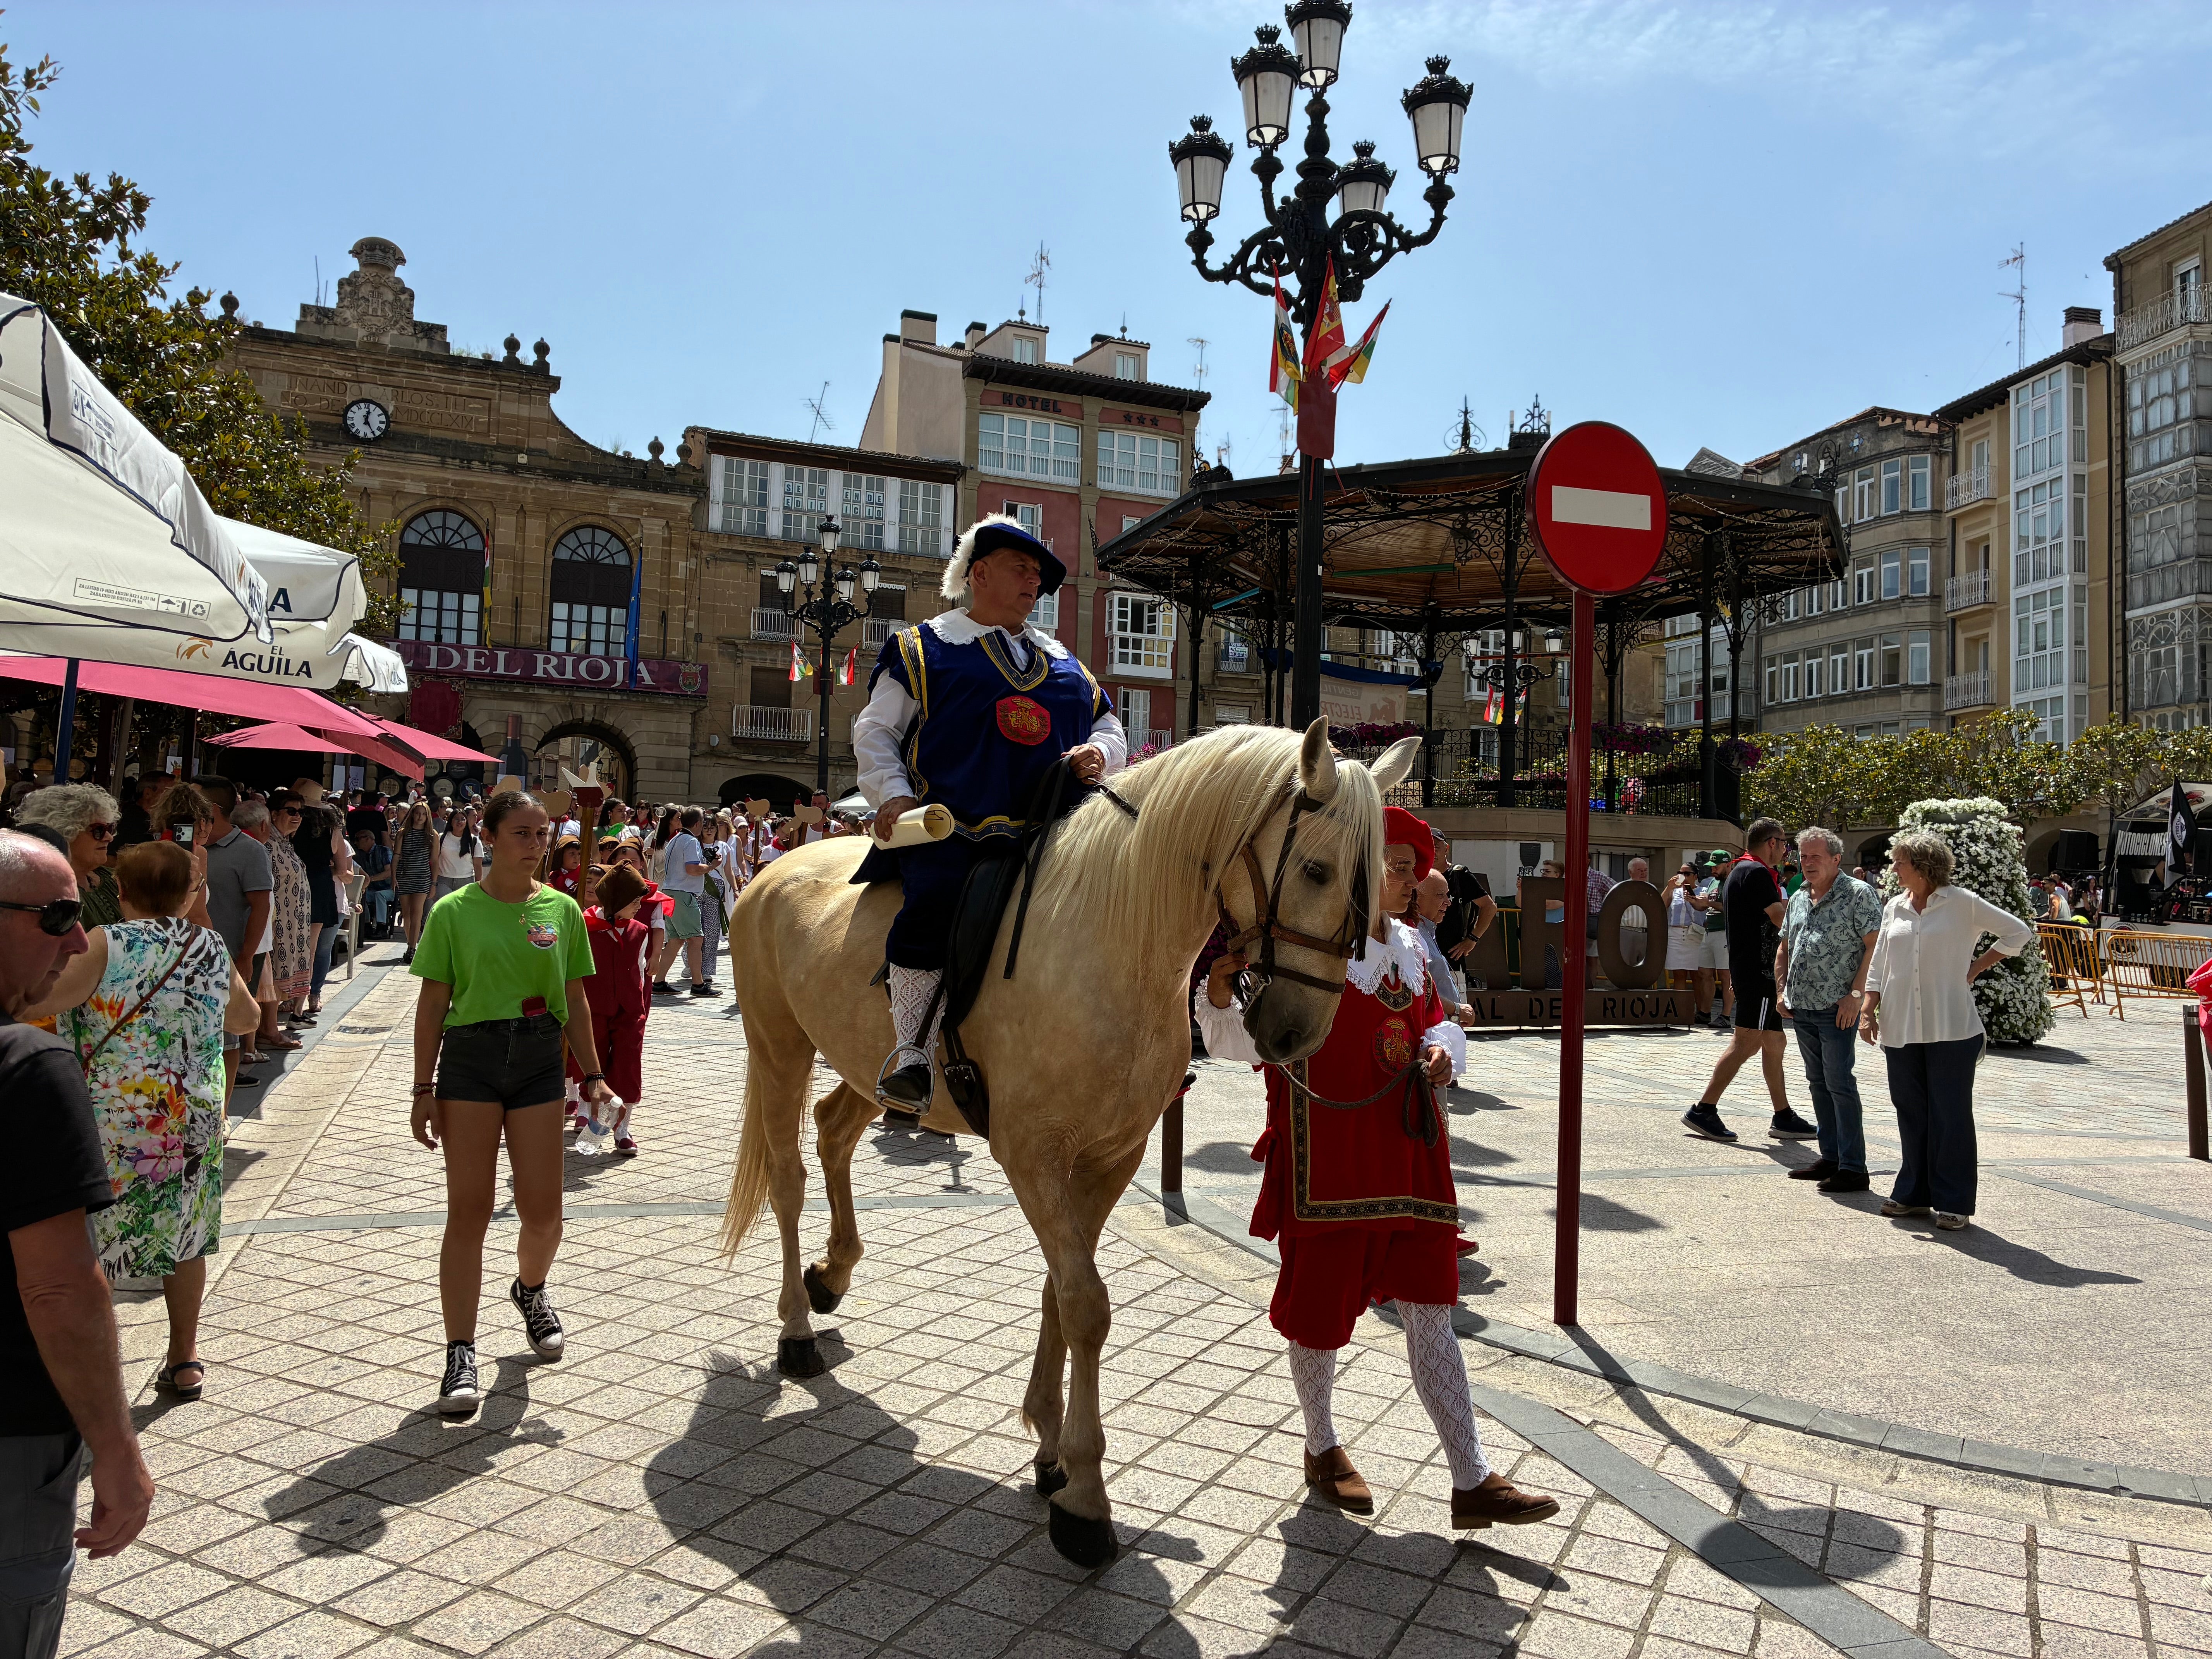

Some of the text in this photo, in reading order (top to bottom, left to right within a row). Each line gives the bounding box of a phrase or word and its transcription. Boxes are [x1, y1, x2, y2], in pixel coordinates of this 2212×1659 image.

[1003, 393, 1061, 412] HOTEL
[786, 484, 881, 503] SE VENDE
[786, 498, 881, 517] EDIFICIO
[271, 645, 284, 656] EL
[221, 647, 313, 678] ÁGUILA
[425, 645, 521, 676] DEL
[532, 653, 656, 688] RIOJA
[1528, 998, 1562, 1020] DE
[1603, 997, 1679, 1018] RIOJA
